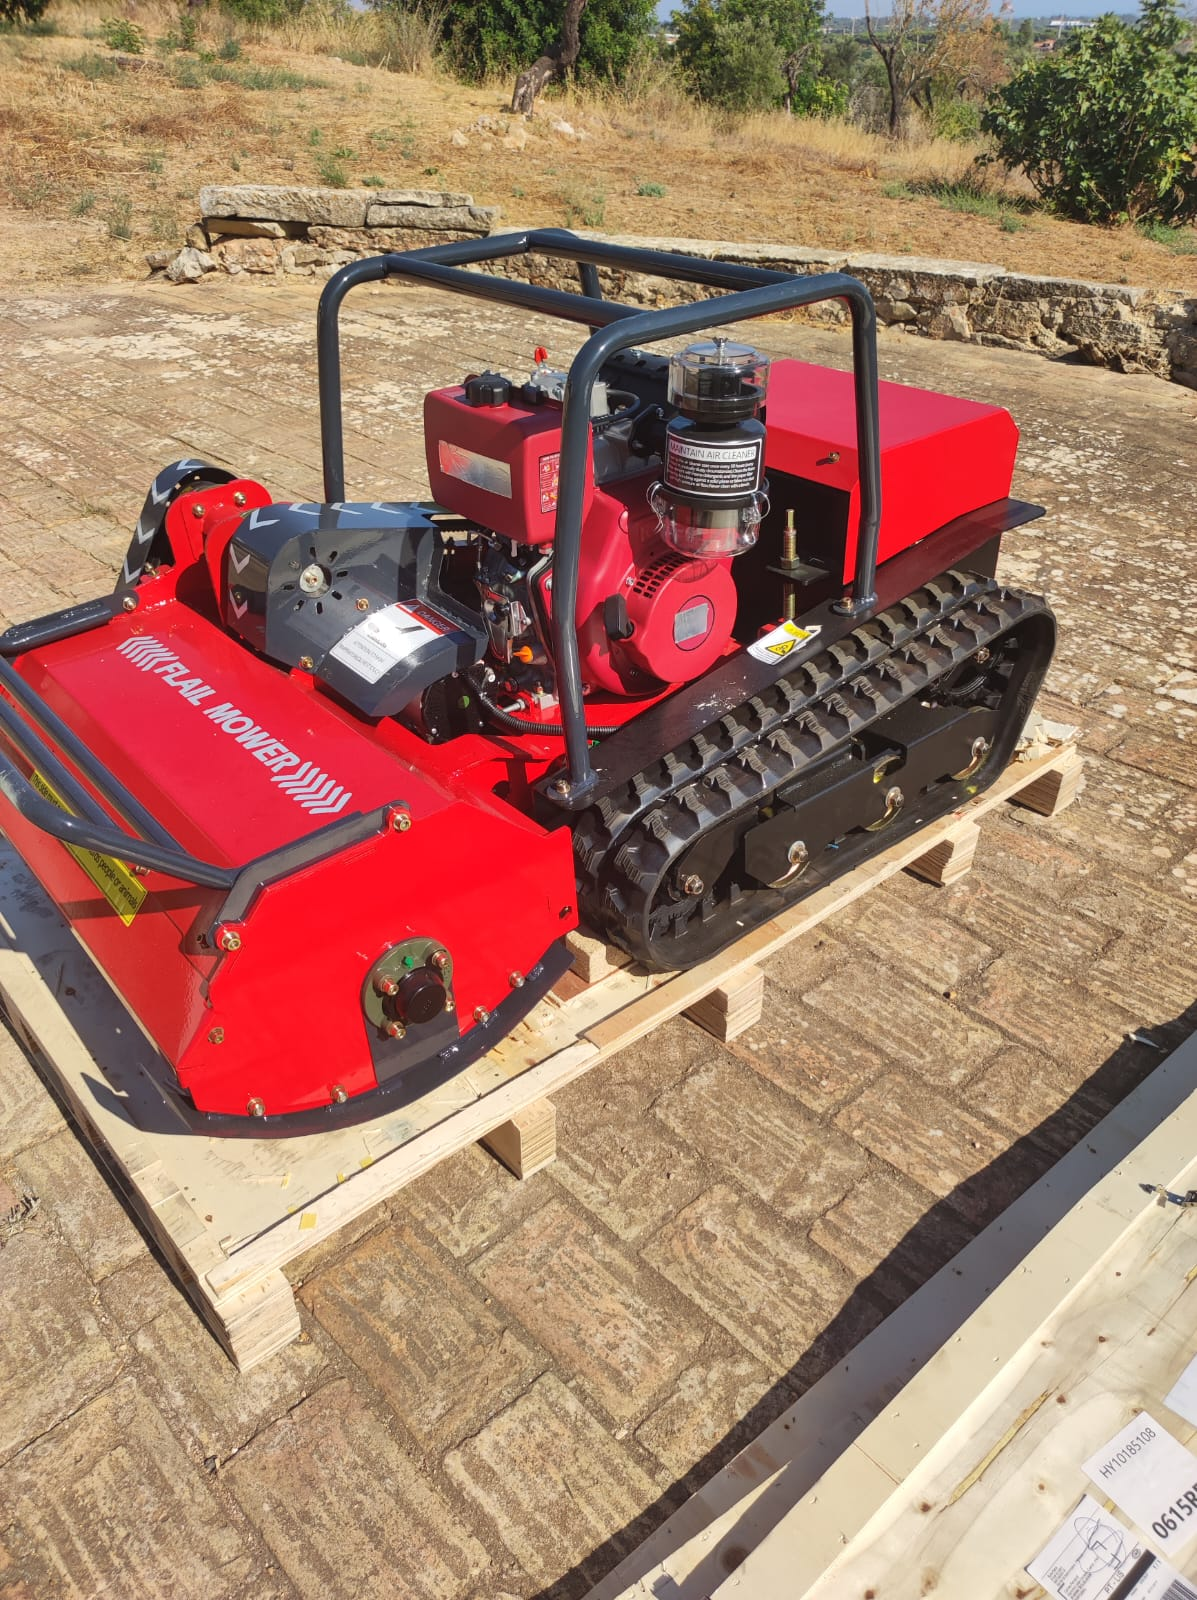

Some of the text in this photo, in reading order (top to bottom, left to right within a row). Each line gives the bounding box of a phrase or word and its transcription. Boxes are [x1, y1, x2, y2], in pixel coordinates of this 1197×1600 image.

[670, 442, 755, 460] MAINTAIN AIR CLEANER
[417, 610, 450, 631] DANGER
[154, 661, 301, 773] FLAIL MOWER
[97, 859, 117, 882] people
[119, 885, 138, 909] animals
[1099, 1427, 1156, 1479] HY10185108
[1152, 1482, 1197, 1539] 0615R
